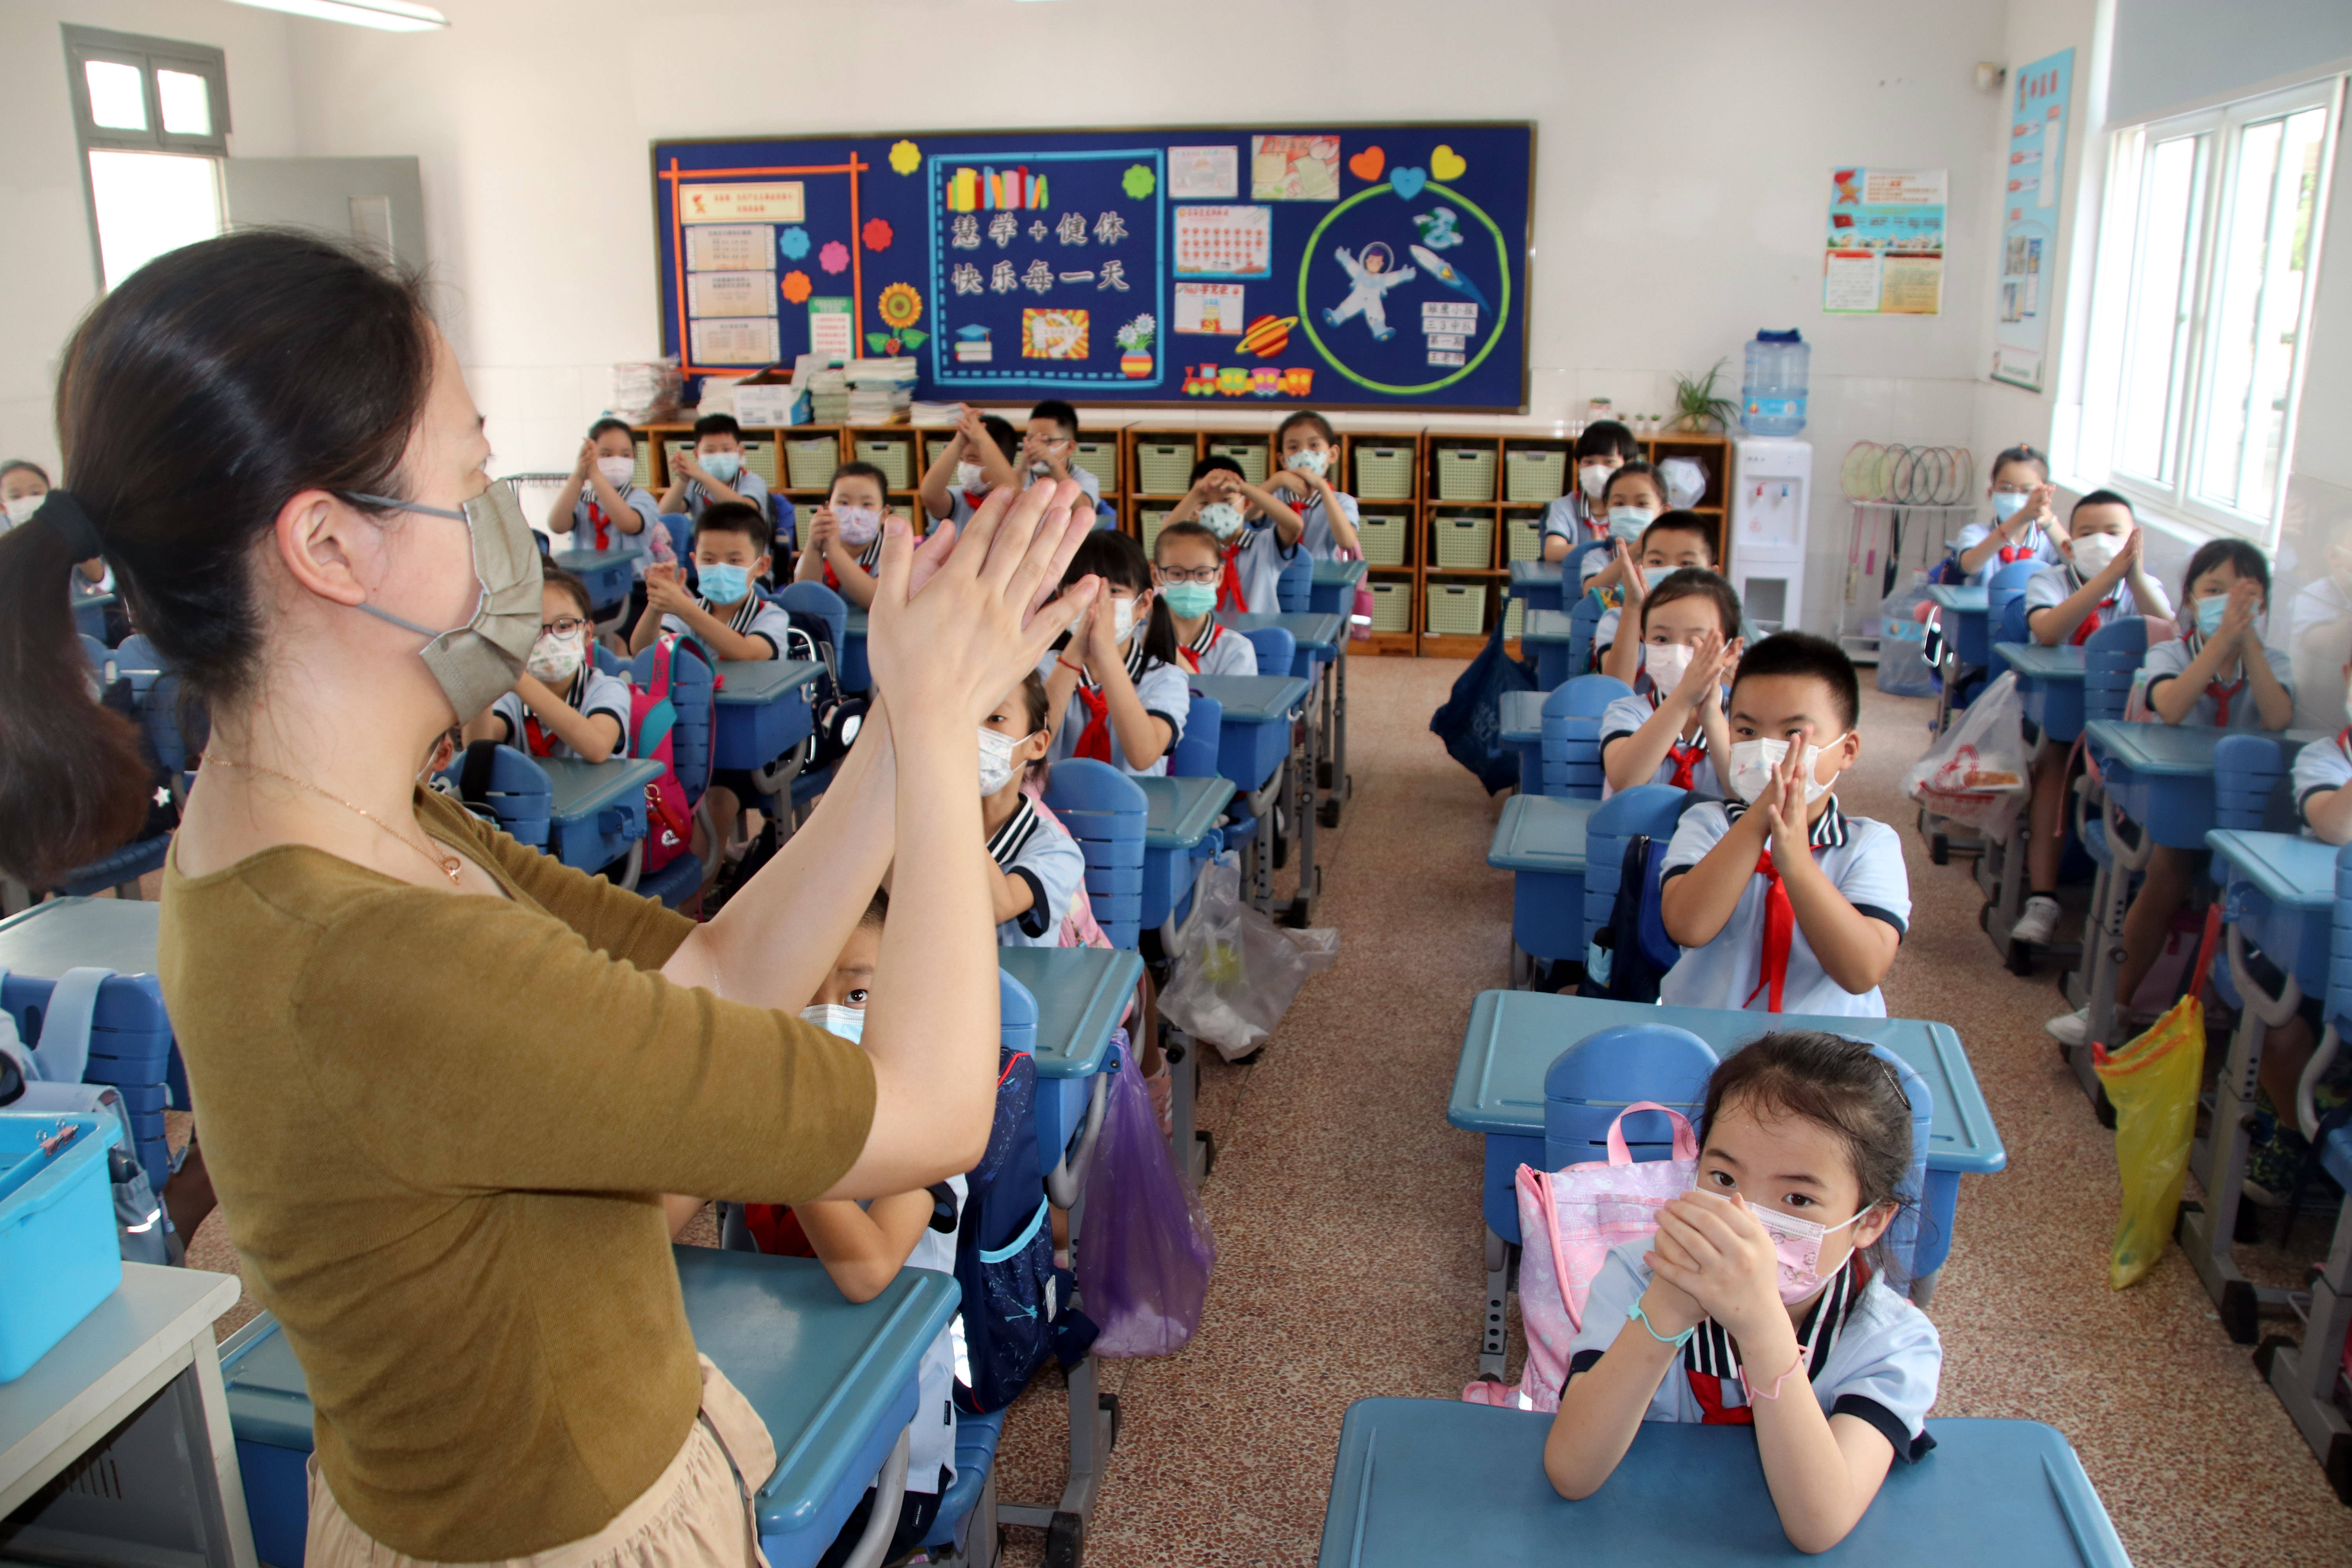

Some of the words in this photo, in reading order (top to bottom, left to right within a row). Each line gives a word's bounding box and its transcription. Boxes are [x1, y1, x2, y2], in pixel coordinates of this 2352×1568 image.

[951, 211, 1128, 250] 慧学+健体
[951, 260, 1130, 296] 快乐每一天
[1426, 319, 1473, 332] 三3中队
[1430, 334, 1463, 346] 第一期
[1428, 352, 1463, 363] 王老师
